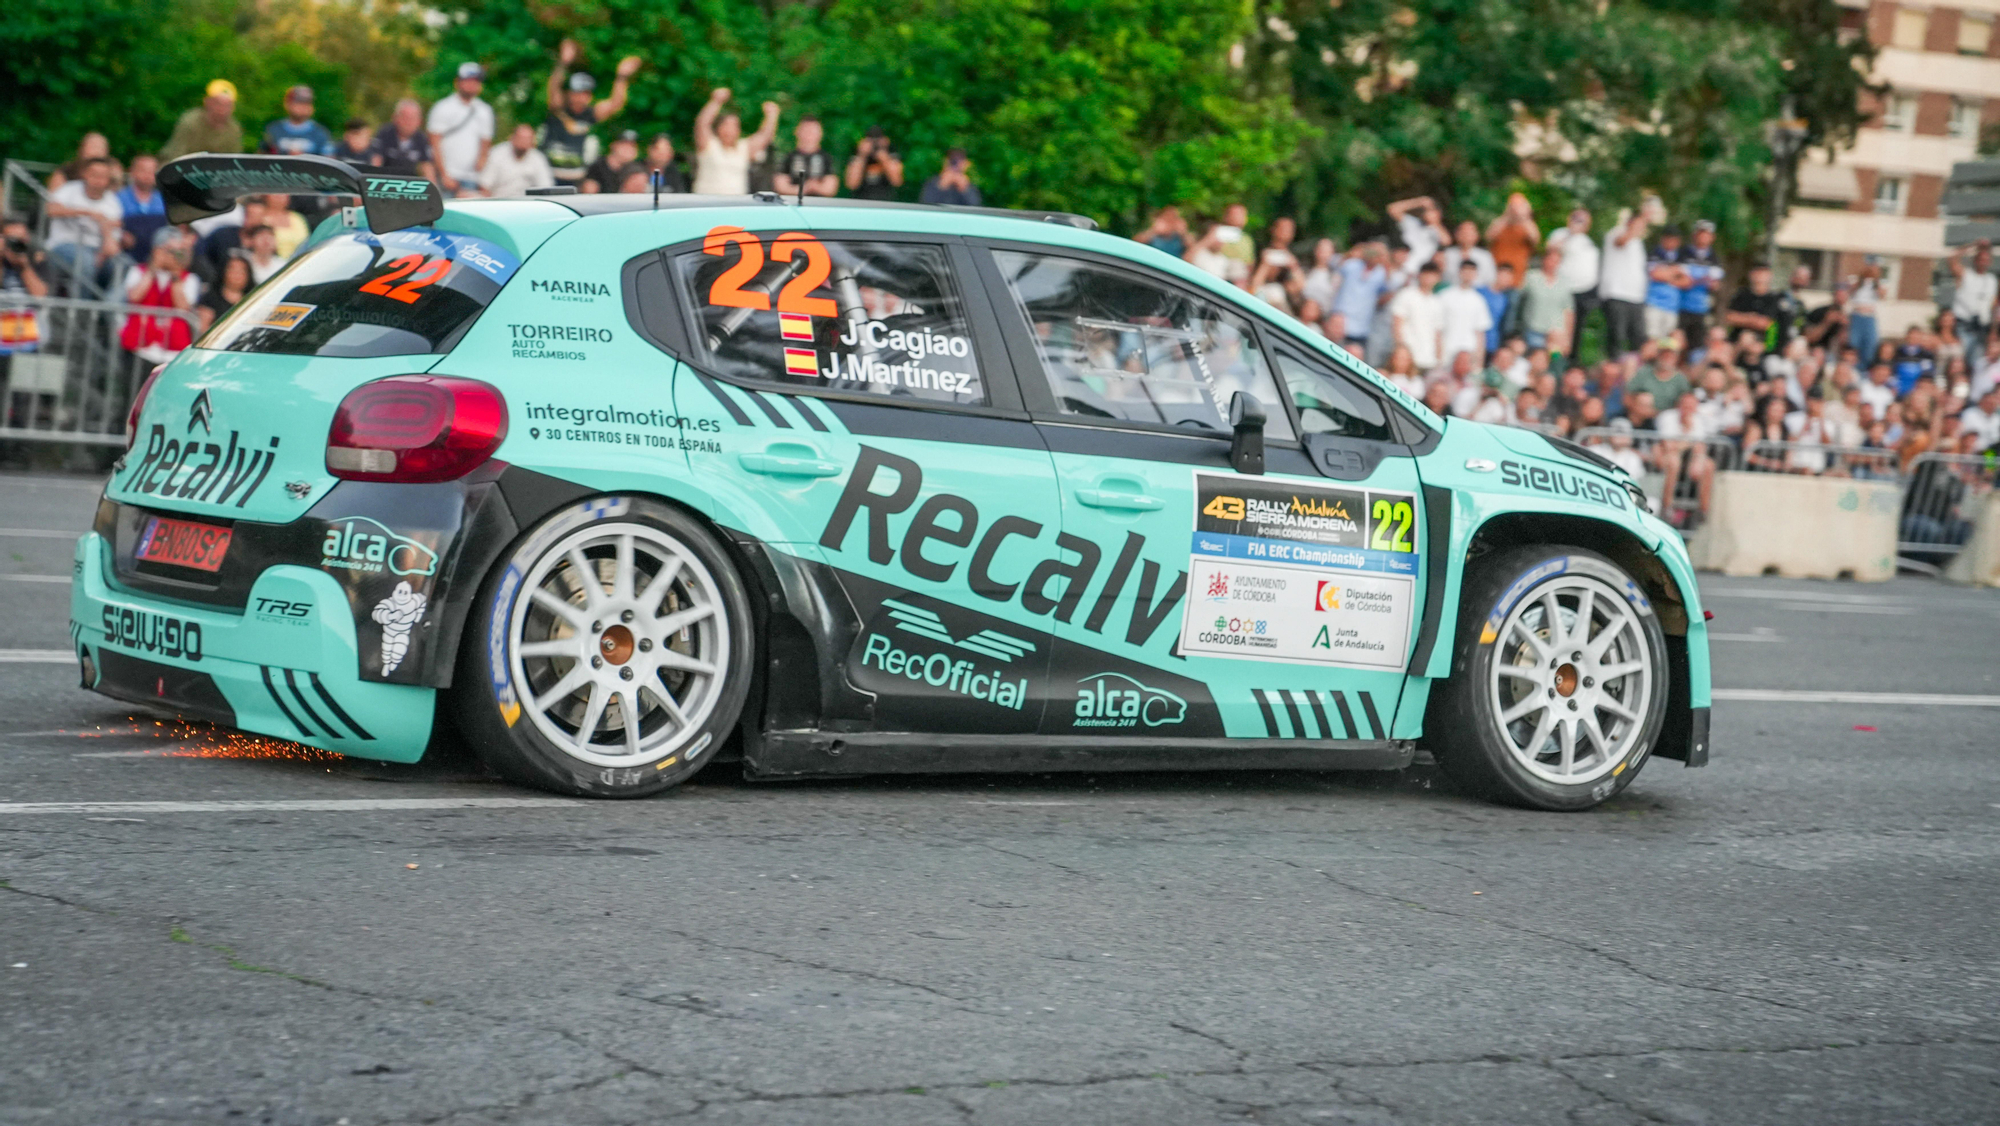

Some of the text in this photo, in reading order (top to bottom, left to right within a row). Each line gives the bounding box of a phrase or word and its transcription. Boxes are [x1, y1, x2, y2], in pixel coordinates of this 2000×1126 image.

[365, 178, 431, 194] TRS
[358, 253, 453, 305] 22
[703, 225, 839, 318] 22
[531, 280, 611, 297] MARINA
[551, 295, 594, 303] RACEWEAR
[507, 324, 613, 343] TORREIRO
[511, 340, 546, 349] AUTO
[840, 319, 969, 360] J.Cagiao
[512, 349, 587, 361] RECAMBIOS
[821, 352, 973, 394] J.Martínez
[525, 402, 721, 433] integralmotion.es
[546, 429, 723, 455] 30 CENTROS EN TODA ESPAÑA
[122, 424, 280, 508] Recalvi
[1323, 447, 1365, 472] C3
[1203, 495, 1246, 521] 43
[1246, 495, 1352, 521] RALLY Andalucía
[1246, 510, 1358, 533] SIERRA MORENA
[1371, 499, 1413, 553] 22
[322, 521, 387, 562] alca
[819, 443, 1188, 662] Recalv
[1247, 542, 1365, 569] FIA ERC Championship
[1234, 575, 1287, 591] AYUNTAMIENTO
[1346, 588, 1393, 602] Diputación
[256, 597, 314, 617] TRS
[1232, 588, 1277, 603] DE CÓRDOBA
[1344, 601, 1392, 613] de Córdoba
[1198, 631, 1247, 646] CÓRDOBA
[1333, 639, 1385, 651] de Andalucía
[1335, 628, 1358, 638] Junta
[861, 633, 1028, 711] RecOficial
[1075, 679, 1141, 718] alca
[1072, 718, 1118, 728] Asistencia
